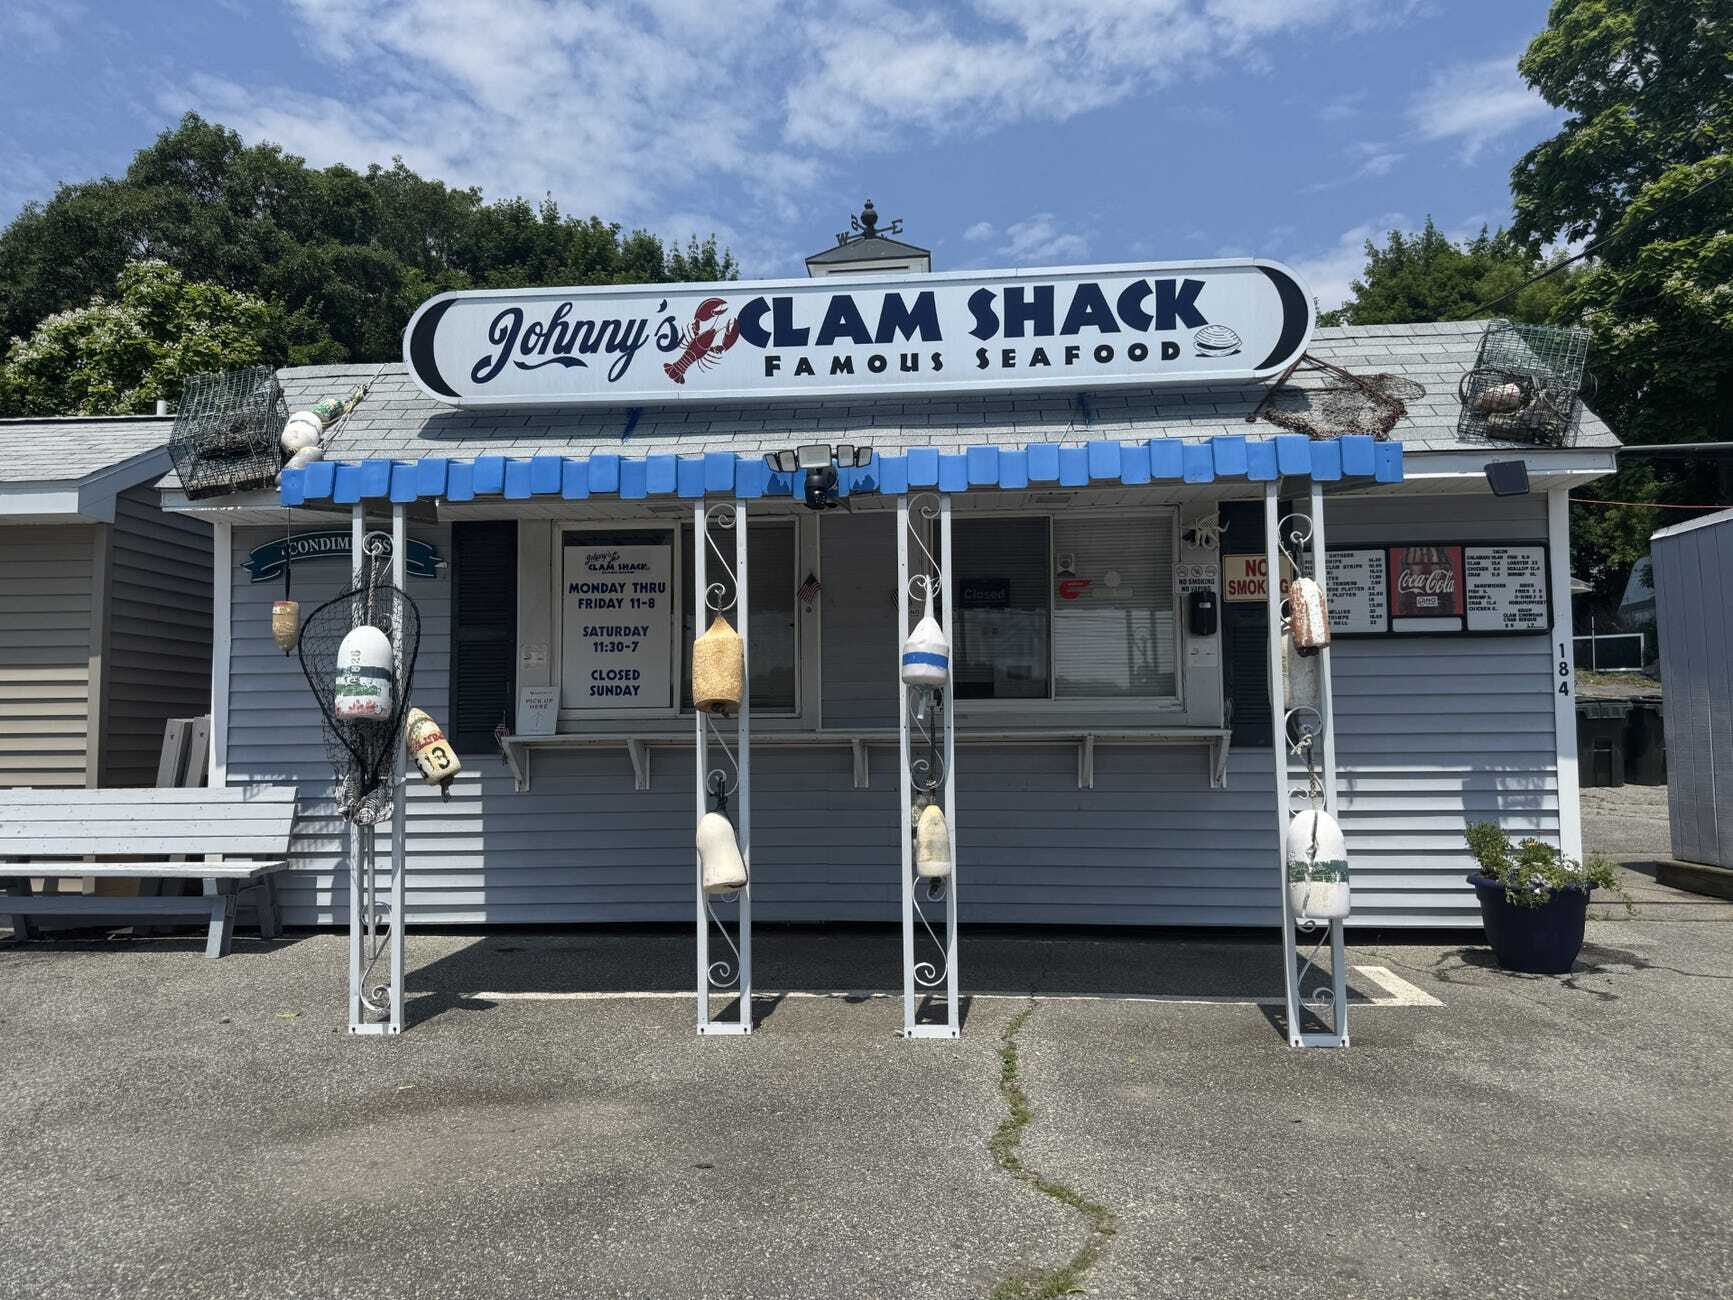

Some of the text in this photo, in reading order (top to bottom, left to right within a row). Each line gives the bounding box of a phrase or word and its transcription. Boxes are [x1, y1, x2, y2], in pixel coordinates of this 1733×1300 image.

[736, 278, 1209, 349] CLAM SHACK
[471, 299, 684, 384] Johnny's
[764, 341, 1182, 377] FAMOUS SEAFOOD
[289, 534, 393, 555] CONDIMTS
[588, 563, 615, 571] CLAM
[569, 582, 666, 594] MONDAY THRU
[964, 586, 1006, 601] Closed
[1228, 579, 1289, 597] SMOKG
[578, 597, 655, 609] FRIDAY 11-8
[582, 626, 649, 637] SATURDAY
[593, 641, 640, 652] 11:30-7
[591, 669, 641, 681] CLOSED
[1558, 643, 1570, 697] 184
[590, 685, 641, 696] SUNDAY
